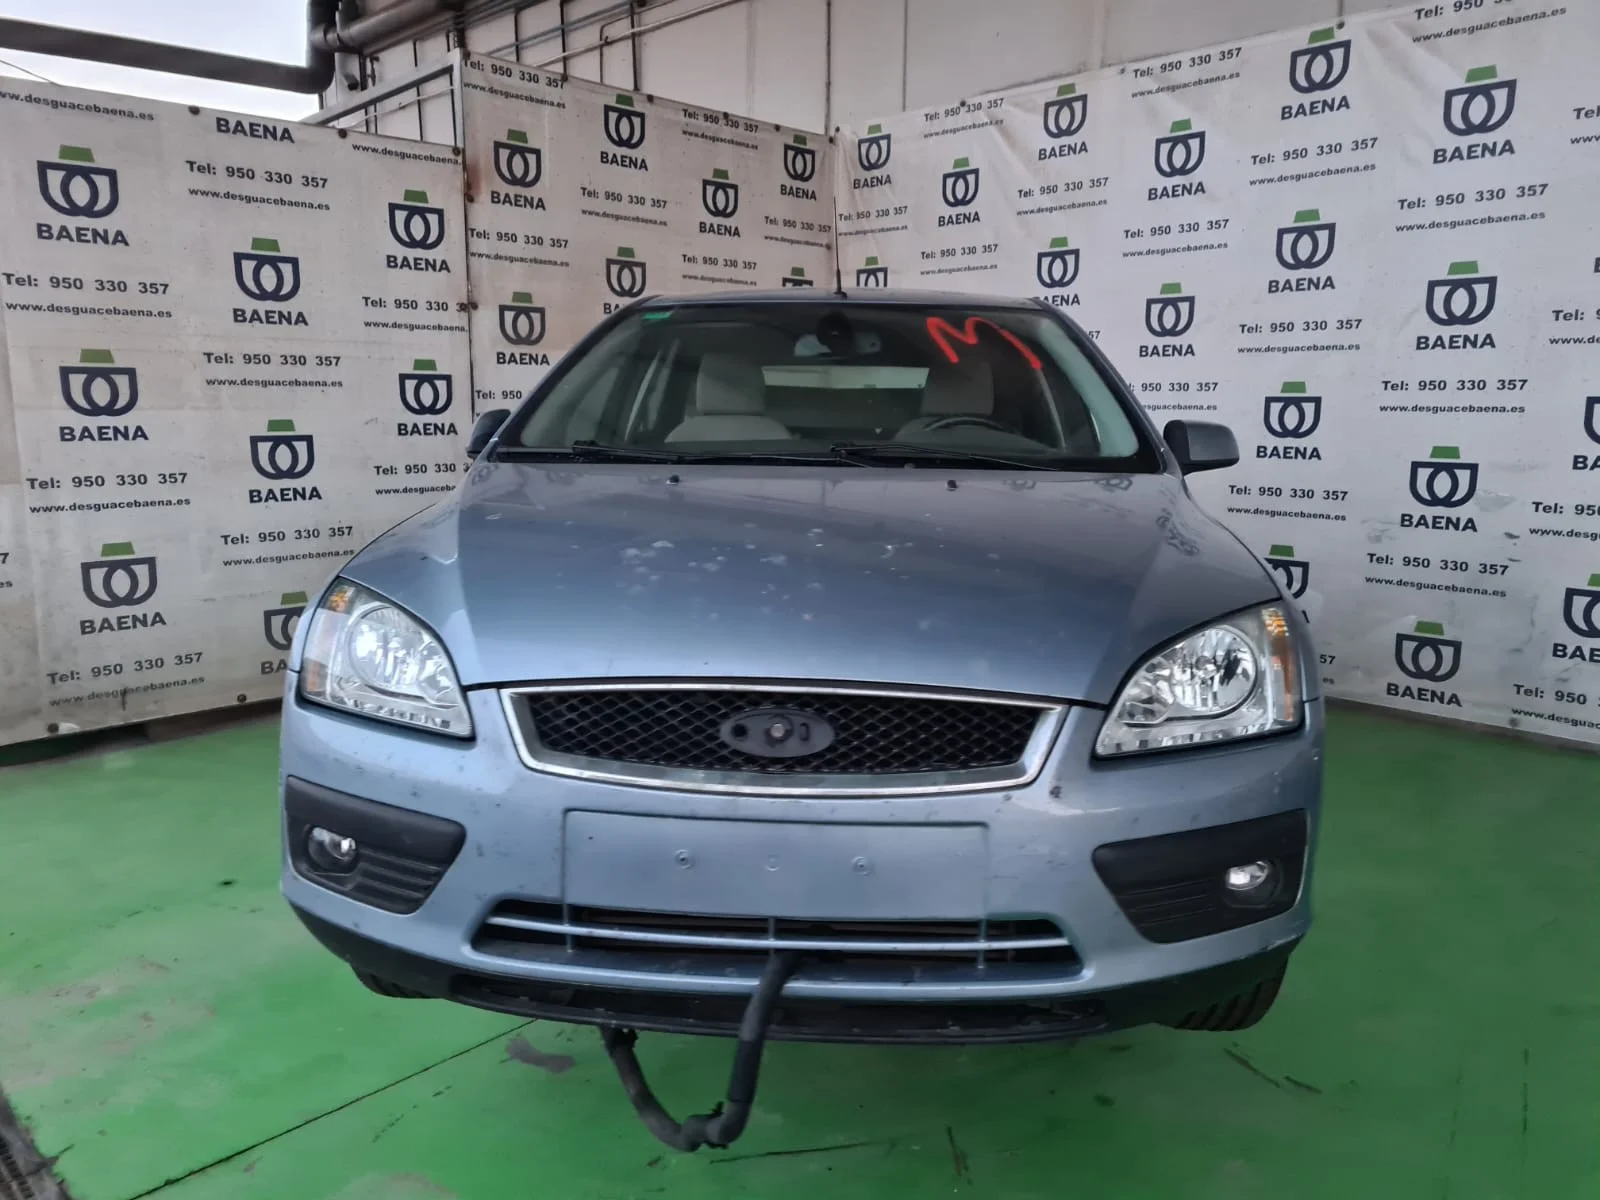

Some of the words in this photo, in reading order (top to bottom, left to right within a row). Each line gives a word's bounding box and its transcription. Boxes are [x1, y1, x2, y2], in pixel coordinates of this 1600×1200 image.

[1414, 5, 1444, 20] Tel:
[1412, 8, 1566, 42] www.desguacebaena.es
[464, 60, 484, 71] Tel:
[491, 64, 512, 78] 950
[519, 70, 540, 84] 330
[1133, 67, 1154, 79] Tel:
[1160, 60, 1181, 73] 950
[1189, 54, 1211, 67] 330
[1219, 47, 1241, 61] 357
[1281, 96, 1350, 120] BAENA
[216, 117, 295, 144] BAENA
[1038, 141, 1088, 160] BAENA
[1250, 153, 1275, 165] Tel:
[1283, 148, 1308, 161] 950
[1316, 143, 1342, 156] 330
[1351, 137, 1378, 151] 357
[1433, 140, 1515, 164] BAENA
[600, 151, 648, 171] BAENA
[185, 160, 216, 175] Tel:
[226, 166, 255, 180] 950
[264, 171, 292, 184] 330
[301, 176, 328, 188] 357
[853, 174, 892, 189] BAENA
[1250, 164, 1376, 186] www.desguacebaena.es
[780, 184, 817, 201] BAENA
[1017, 188, 1035, 199] Tel:
[1040, 184, 1058, 195] 950
[1064, 181, 1083, 192] 330
[1089, 177, 1108, 188] 357
[1148, 182, 1206, 201] BAENA
[1398, 197, 1425, 210] Tel:
[1436, 193, 1465, 206] 950
[1475, 188, 1505, 202] 330
[1516, 184, 1548, 198] 357
[188, 189, 330, 210] www.desguacebaena.es
[491, 190, 546, 211] BAENA
[580, 187, 599, 199] Tel:
[605, 191, 622, 202] 950
[628, 195, 645, 206] 330
[651, 198, 667, 208] 357
[938, 211, 980, 227] BAENA
[1396, 212, 1545, 232] www.desguacebaena.es
[37, 223, 129, 246] BAENA
[470, 228, 490, 240] Tel:
[496, 232, 517, 243] 950
[524, 235, 543, 246] 330
[550, 238, 568, 248] 357
[699, 221, 741, 238] BAENA
[1123, 228, 1144, 239] Tel:
[1150, 225, 1171, 236] 950
[1178, 222, 1199, 233] 330
[1207, 219, 1229, 230] 357
[1123, 243, 1227, 257] www.desguacebaena.es
[386, 255, 451, 273] BAENA
[2, 273, 38, 287] Tel:
[49, 276, 83, 290] 950
[95, 280, 127, 292] 330
[138, 282, 169, 295] 357
[1268, 276, 1335, 294] BAENA
[6, 303, 172, 318] www.desguacebaena.es
[362, 296, 387, 308] Tel:
[394, 299, 418, 310] 950
[426, 301, 448, 311] 330
[233, 308, 309, 326] BAENA
[1552, 309, 1584, 321] Tel:
[1240, 324, 1262, 333] Tel:
[1270, 322, 1294, 333] 950
[1303, 320, 1327, 331] 330
[1336, 319, 1362, 330] 357
[1139, 344, 1195, 357] BAENA
[1238, 344, 1360, 354] www.desguacebaena.es
[1416, 333, 1496, 350] BAENA
[203, 352, 234, 364] Tel:
[243, 354, 271, 365] 950
[280, 354, 306, 366] 330
[315, 356, 341, 366] 357
[497, 352, 550, 365] BAENA
[206, 378, 343, 388] www.desguacebaena.es
[1141, 383, 1161, 392] 950
[1169, 383, 1189, 392] 330
[1197, 382, 1218, 392] 357
[1382, 380, 1408, 391] Tel:
[1418, 380, 1447, 391] 950
[1456, 380, 1486, 391] 330
[1497, 379, 1528, 390] 357
[475, 389, 496, 400] Tel:
[502, 390, 522, 399] 950
[1380, 404, 1525, 414] www.desguacebaena.es
[59, 425, 149, 442] BAENA
[397, 422, 458, 436] BAENA
[1256, 445, 1321, 460] BAENA
[374, 465, 397, 475] Tel:
[405, 464, 427, 474] 950
[435, 463, 456, 473] 330
[26, 477, 60, 489] Tel:
[72, 475, 105, 488] 950
[116, 474, 148, 486] 330
[158, 473, 187, 484] 357
[249, 486, 322, 504] BAENA
[1229, 485, 1251, 495] Tel:
[1259, 487, 1282, 497] 950
[1290, 488, 1314, 499] 330
[1323, 490, 1348, 501] 357
[29, 499, 190, 513] www.desguacebaena.es
[1227, 508, 1346, 521] www.desguacebaena.es
[1532, 502, 1563, 514] Tel:
[1400, 513, 1478, 532] BAENA
[220, 534, 249, 545] Tel:
[258, 531, 285, 542] 950
[294, 528, 320, 540] 330
[328, 526, 353, 537] 357
[223, 550, 355, 566] www.desguacebaena.es
[1367, 553, 1393, 565] Tel:
[1403, 556, 1430, 568] 950
[1440, 560, 1469, 572] 330
[1478, 563, 1509, 575] 357
[1365, 577, 1506, 597] www.desguacebaena.es
[80, 612, 166, 635] BAENA
[47, 670, 80, 685] Tel:
[91, 664, 123, 677] 950
[134, 658, 164, 671] 330
[175, 652, 202, 665] 357
[1386, 682, 1462, 707] BAENA
[1513, 684, 1544, 699] Tel:
[1555, 690, 1587, 705] 950
